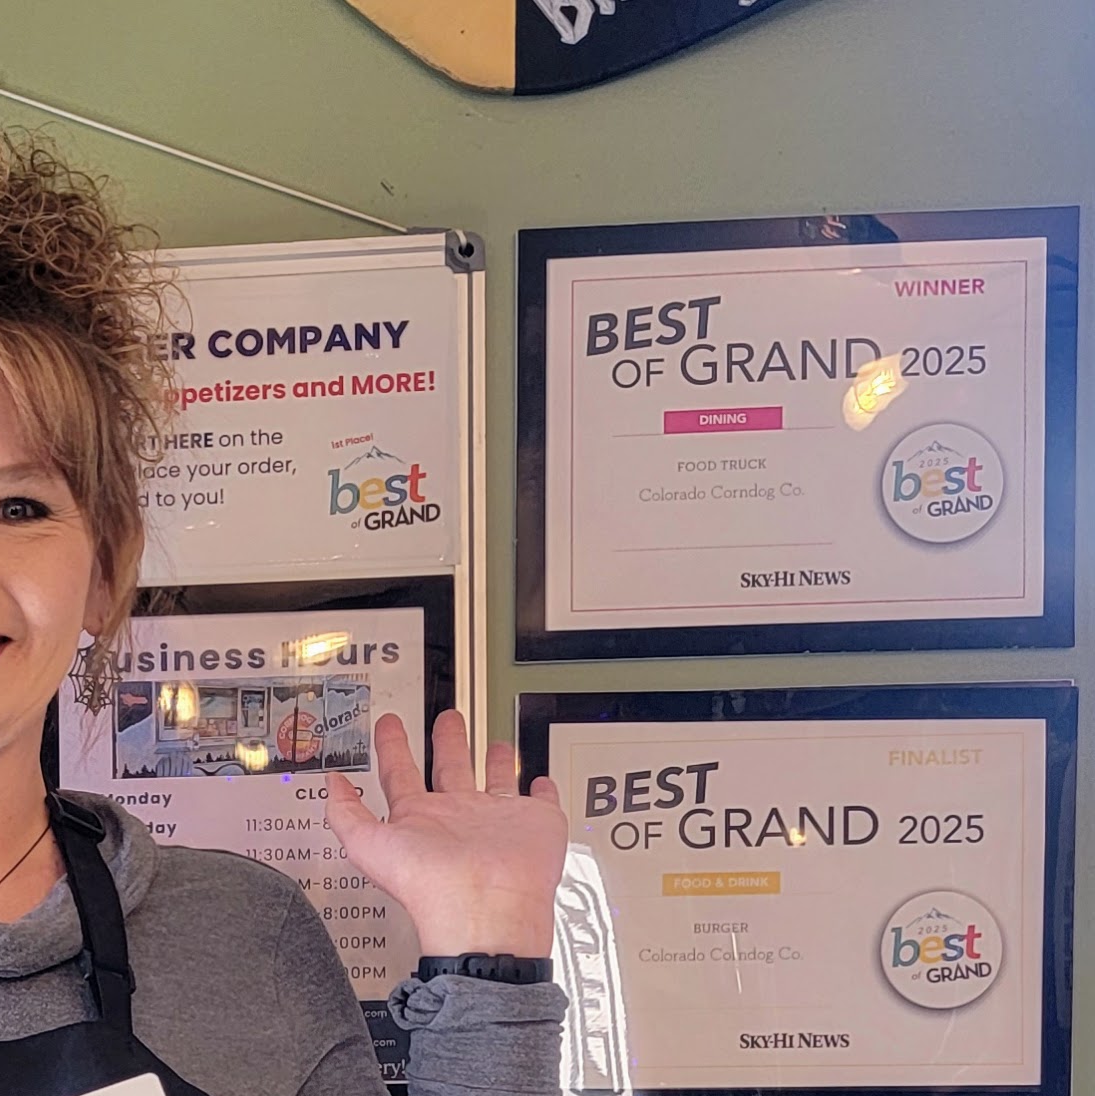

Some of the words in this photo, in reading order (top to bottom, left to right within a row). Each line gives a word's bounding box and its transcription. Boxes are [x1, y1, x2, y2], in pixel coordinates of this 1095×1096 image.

[895, 279, 985, 297] WINNER
[586, 296, 721, 357] BEST
[208, 320, 410, 358] COMPANY
[612, 359, 664, 388] OF
[681, 338, 882, 385] GRAND
[901, 346, 986, 376] 2025
[164, 379, 286, 411] ppetizers
[293, 375, 344, 398] and
[351, 371, 436, 395] MORE!
[699, 413, 747, 426] DINING
[165, 432, 214, 450] HERE
[219, 434, 246, 447] on
[250, 429, 283, 446] the
[331, 439, 344, 449] 1st
[345, 433, 374, 448] Place!
[137, 460, 180, 479] lace
[188, 461, 231, 483] your
[238, 457, 297, 477] order,
[677, 460, 716, 472] FOOD
[721, 458, 766, 471] TRUCK
[919, 457, 950, 468] 2025
[327, 463, 427, 515] best
[892, 457, 983, 501] best
[156, 489, 175, 506] to
[183, 488, 225, 512] you!
[639, 486, 706, 502] Colorado
[711, 485, 775, 501] Corndog
[780, 484, 804, 498] Co.
[351, 517, 362, 529] of
[364, 503, 440, 531] GRAND
[926, 495, 993, 517] GRAND
[799, 570, 851, 586] NEWS
[113, 643, 265, 673] usiness
[888, 749, 983, 766] FINALIST
[585, 762, 719, 818] BEST
[611, 821, 662, 851] OF
[679, 806, 878, 849] GRAND
[898, 815, 985, 844] 2025
[674, 877, 710, 888] FOOD
[715, 877, 725, 888] &
[728, 877, 768, 888] DRINK
[693, 922, 748, 934] BURGER
[639, 948, 705, 963] Colorado
[779, 947, 803, 961] Co.
[891, 925, 982, 969] best
[926, 962, 992, 984] GRAND
[798, 1033, 849, 1049] NEWS
